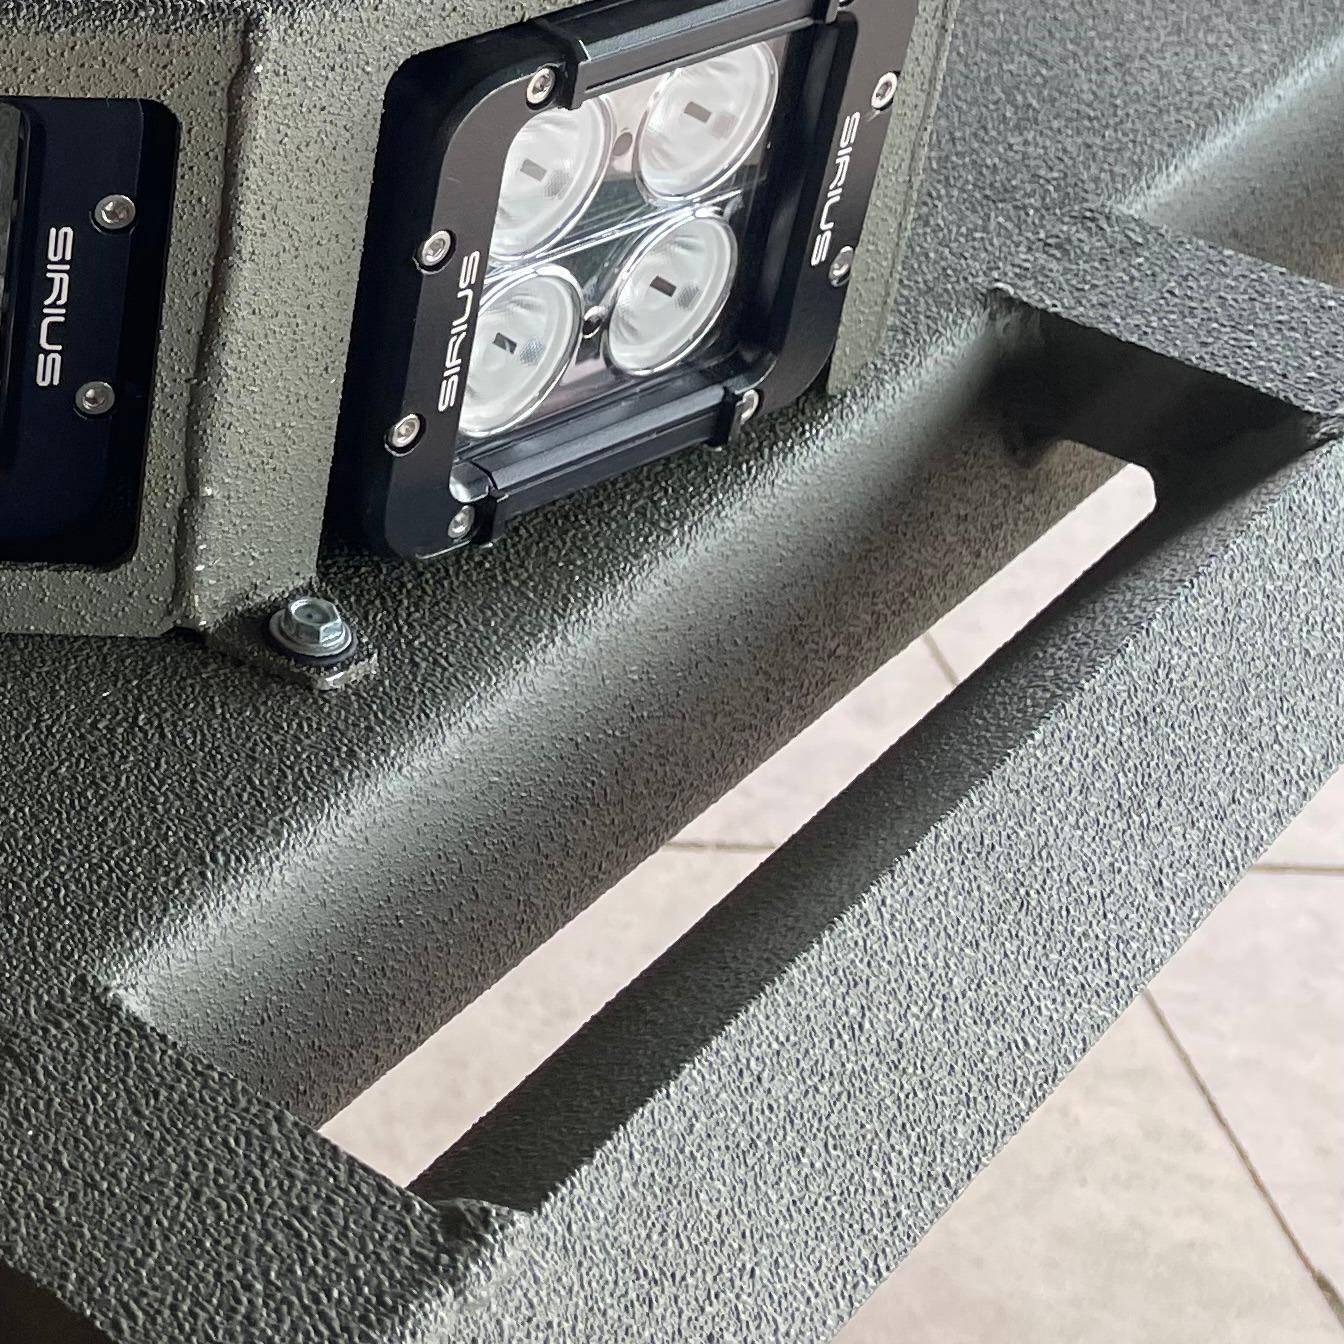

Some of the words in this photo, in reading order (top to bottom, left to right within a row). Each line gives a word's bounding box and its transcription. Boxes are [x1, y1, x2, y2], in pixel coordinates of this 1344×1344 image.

[811, 111, 860, 266] SIRIUS
[36, 226, 74, 386] SIRIUS
[438, 251, 480, 412] SIRIUS
